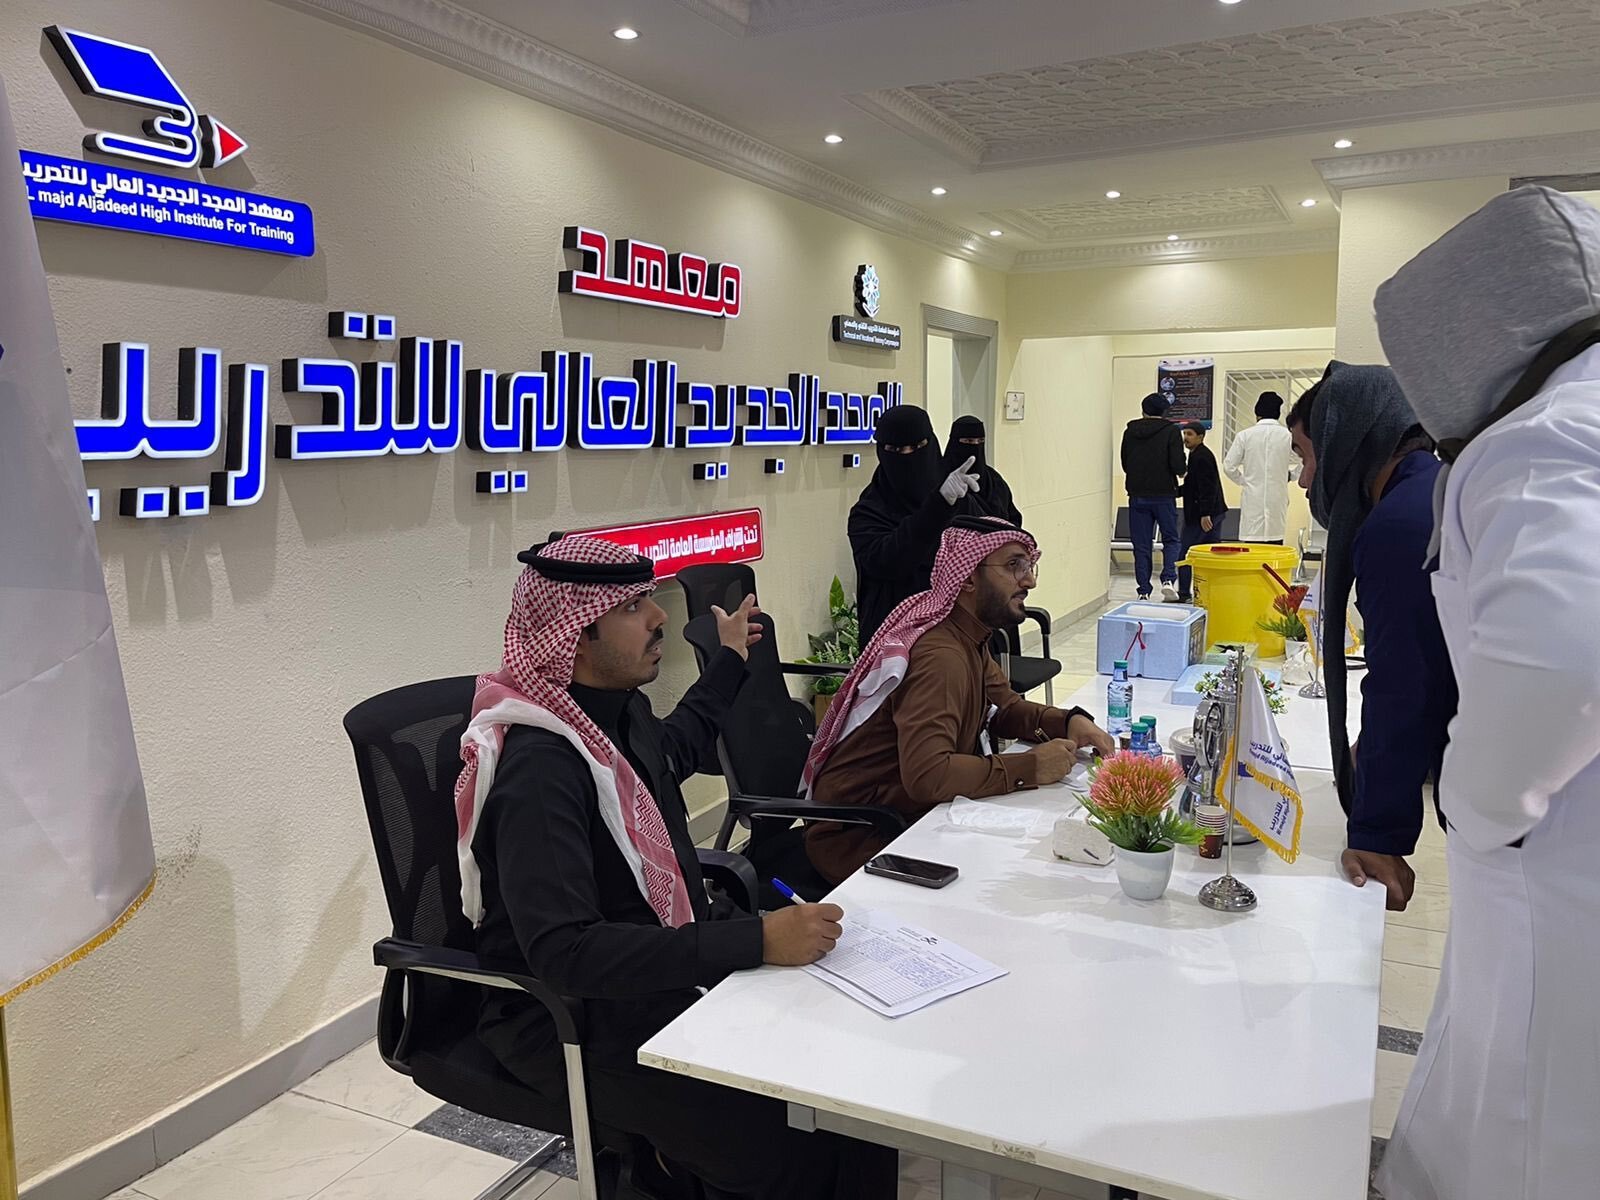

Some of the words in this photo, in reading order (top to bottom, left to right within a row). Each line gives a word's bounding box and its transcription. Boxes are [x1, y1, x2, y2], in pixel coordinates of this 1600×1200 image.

[91, 172, 144, 198] العالي
[146, 183, 199, 207] الجديد
[201, 193, 246, 212] المجد
[248, 201, 294, 222] معهد
[38, 190, 74, 208] majd
[77, 193, 138, 216] Aljadeed
[140, 203, 171, 223] High
[174, 209, 224, 230] Institute
[226, 217, 246, 234] For
[249, 222, 294, 245] Training
[562, 227, 741, 318] معهد
[470, 350, 677, 493] العالي
[682, 373, 820, 481] الجديد
[669, 534, 694, 557] العامة
